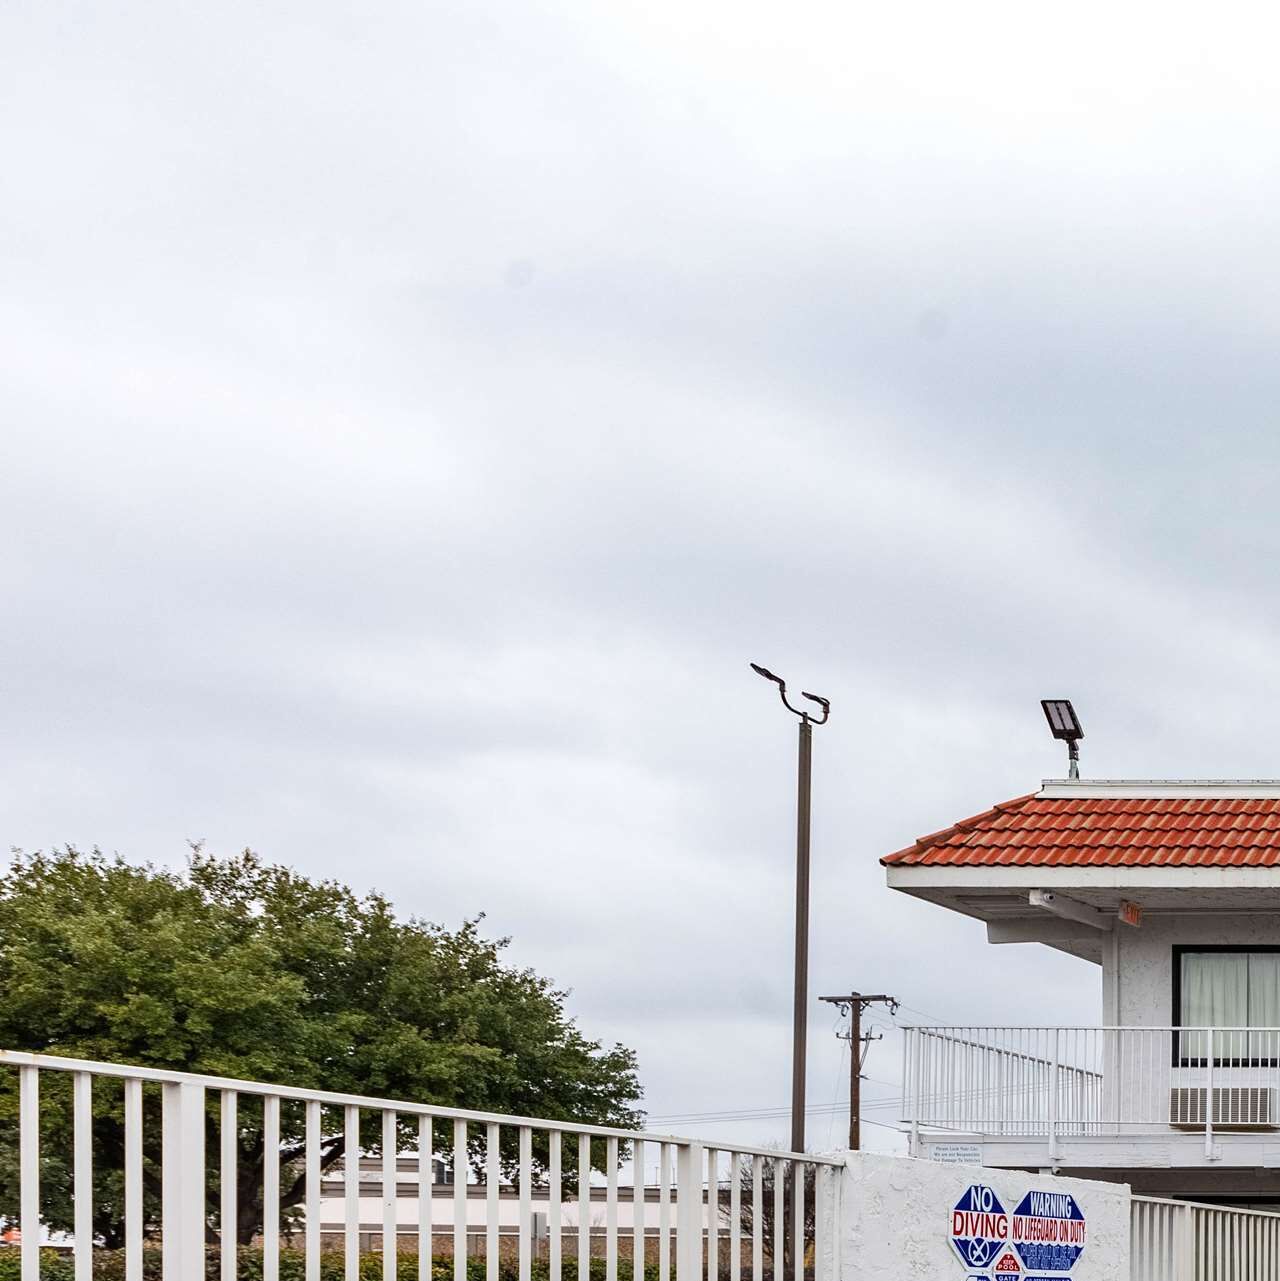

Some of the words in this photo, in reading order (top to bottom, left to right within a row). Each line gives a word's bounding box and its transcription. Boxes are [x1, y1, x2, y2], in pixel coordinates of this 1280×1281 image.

[970, 1186, 993, 1212] NO
[1030, 1192, 1072, 1218] WARNING
[953, 1211, 1008, 1239] DIVING
[1012, 1216, 1023, 1240] NO
[1024, 1217, 1057, 1241] LIFEGUARD
[1060, 1220, 1069, 1242] ON
[1070, 1221, 1086, 1243] DUTY
